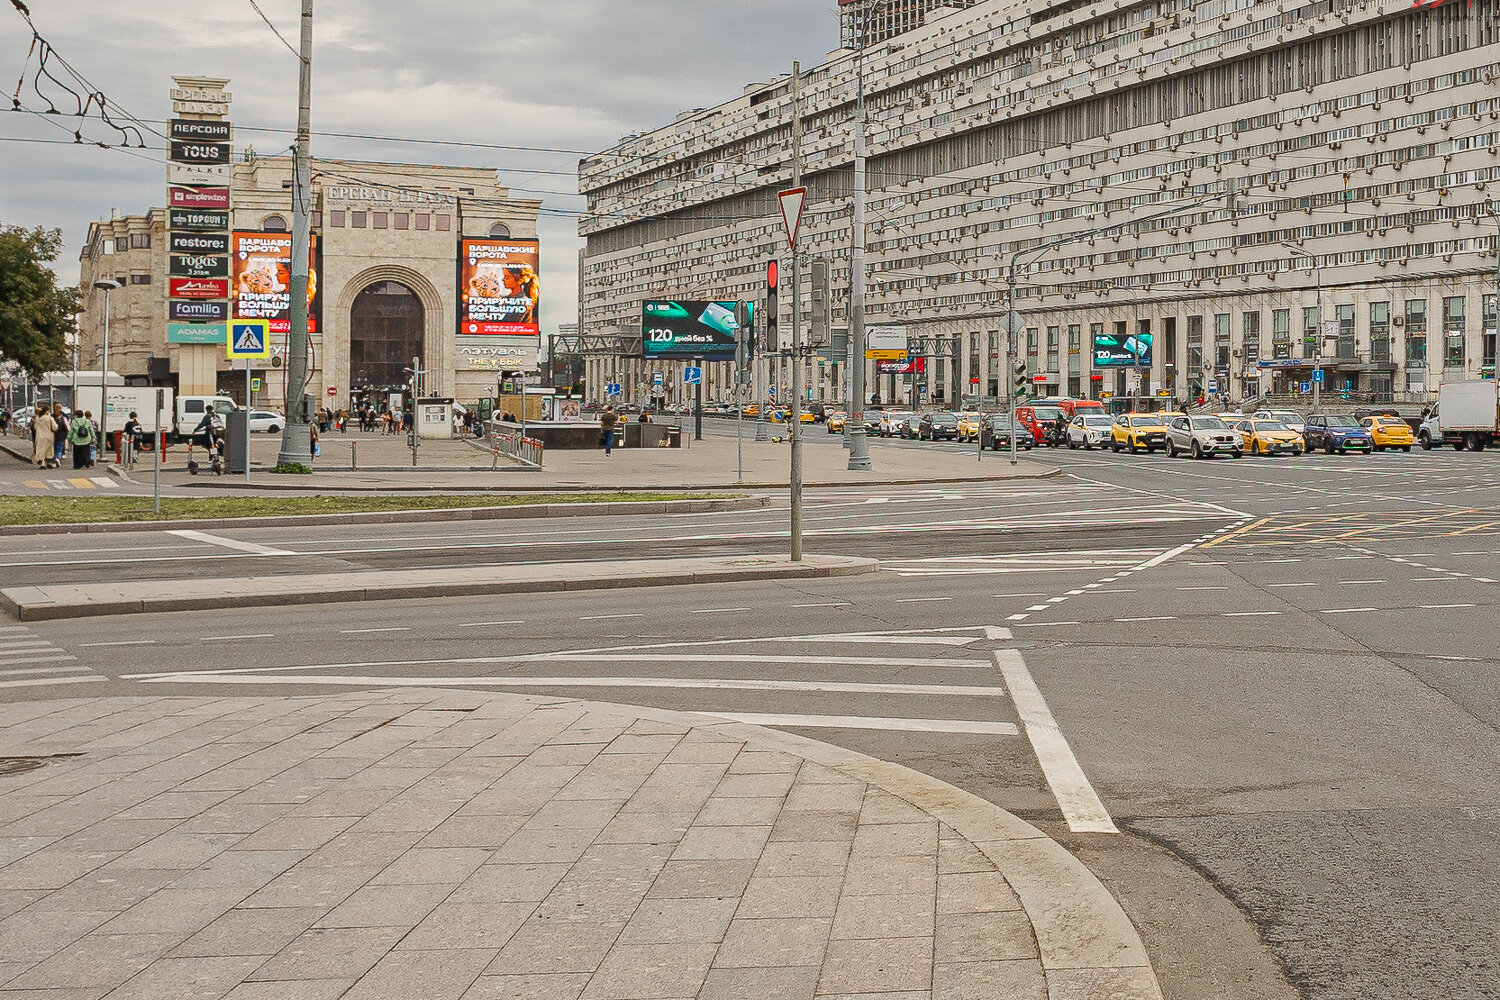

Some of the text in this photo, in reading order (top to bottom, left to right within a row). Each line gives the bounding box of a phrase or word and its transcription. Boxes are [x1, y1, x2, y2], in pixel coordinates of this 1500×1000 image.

[174, 124, 228, 135] ПЕРСОНА
[182, 146, 219, 158] TOUS
[328, 187, 392, 201] ЕРЕВАН
[174, 238, 224, 248] restore:
[239, 238, 291, 247] ВАРШАВС
[239, 245, 281, 253] ВОРОТА
[469, 245, 536, 254] ВАРШАВСКИЕ
[239, 293, 290, 301] ПРИРУЧ
[469, 297, 533, 306] ПРИРУЧИТЕ
[176, 304, 220, 313] familia
[239, 301, 290, 310] БОЛЬШУ
[469, 305, 527, 314] БОЛЬШУЮ
[239, 309, 279, 318] МЕЧТУ
[469, 313, 506, 321] МЕЧТУ
[648, 328, 673, 342] 120
[1096, 350, 1110, 358] 120
[499, 358, 523, 366] БЫК
